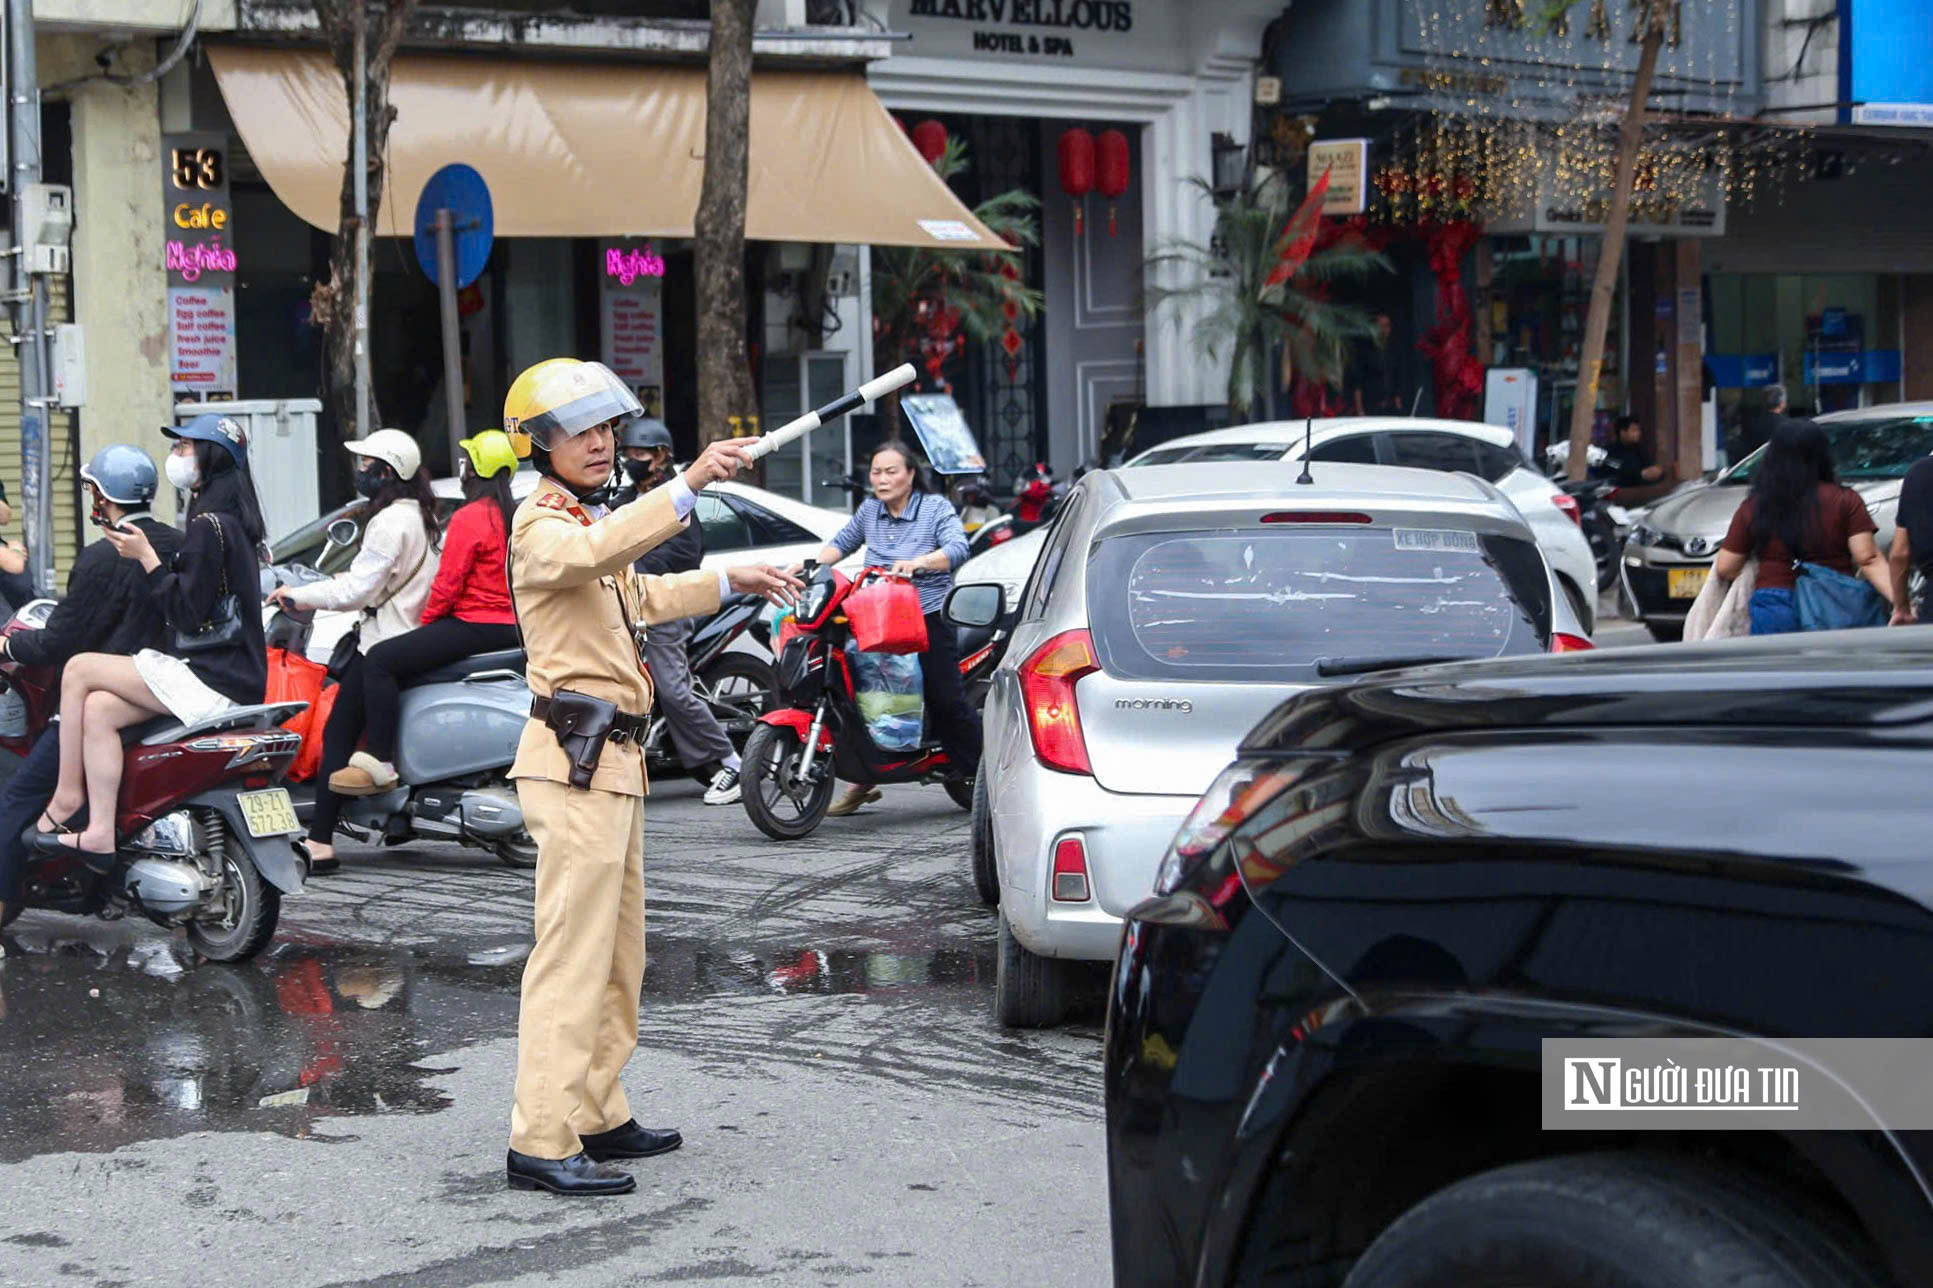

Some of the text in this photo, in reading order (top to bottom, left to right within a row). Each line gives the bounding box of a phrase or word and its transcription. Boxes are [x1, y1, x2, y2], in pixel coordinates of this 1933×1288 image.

[909, 0, 1132, 32] MARVELLOUS
[973, 31, 1074, 57] HOTEL & SPA
[172, 148, 223, 190] 53
[176, 296, 207, 305] Coffee
[176, 309, 226, 319] Egg coffee
[177, 322, 226, 331] Salt coffee
[177, 335, 226, 344] Fresh juice
[178, 347, 221, 356] Smoothie
[178, 360, 199, 369] Beer
[1114, 696, 1193, 714] morning
